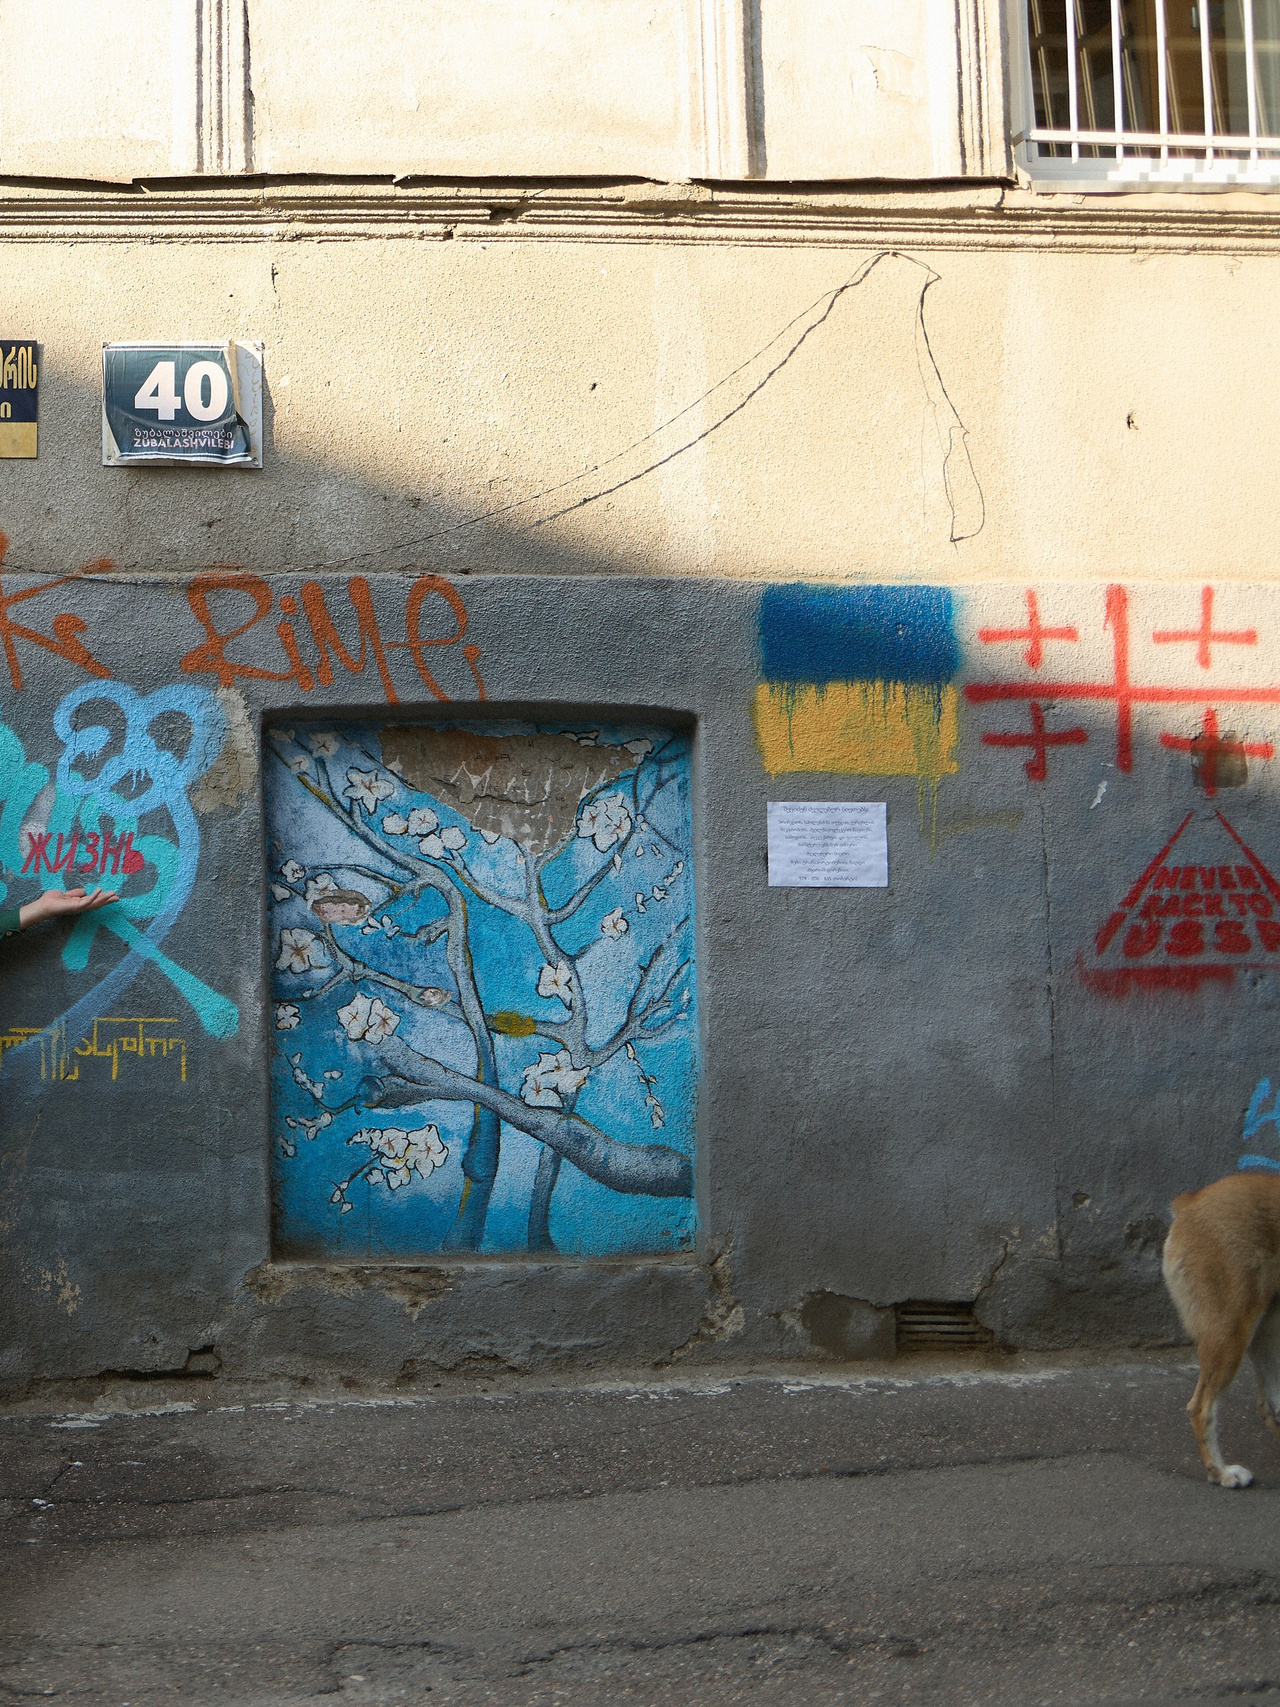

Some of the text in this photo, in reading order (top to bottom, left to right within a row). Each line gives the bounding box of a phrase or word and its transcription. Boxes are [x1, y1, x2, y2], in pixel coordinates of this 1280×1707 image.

[134, 360, 228, 421] 40
[133, 437, 234, 450] ZUBALASHVILEBI
[20, 831, 145, 876] ЖИЗНЬ
[1152, 865, 1262, 890] NEVER
[1139, 892, 1274, 919] BACK TO
